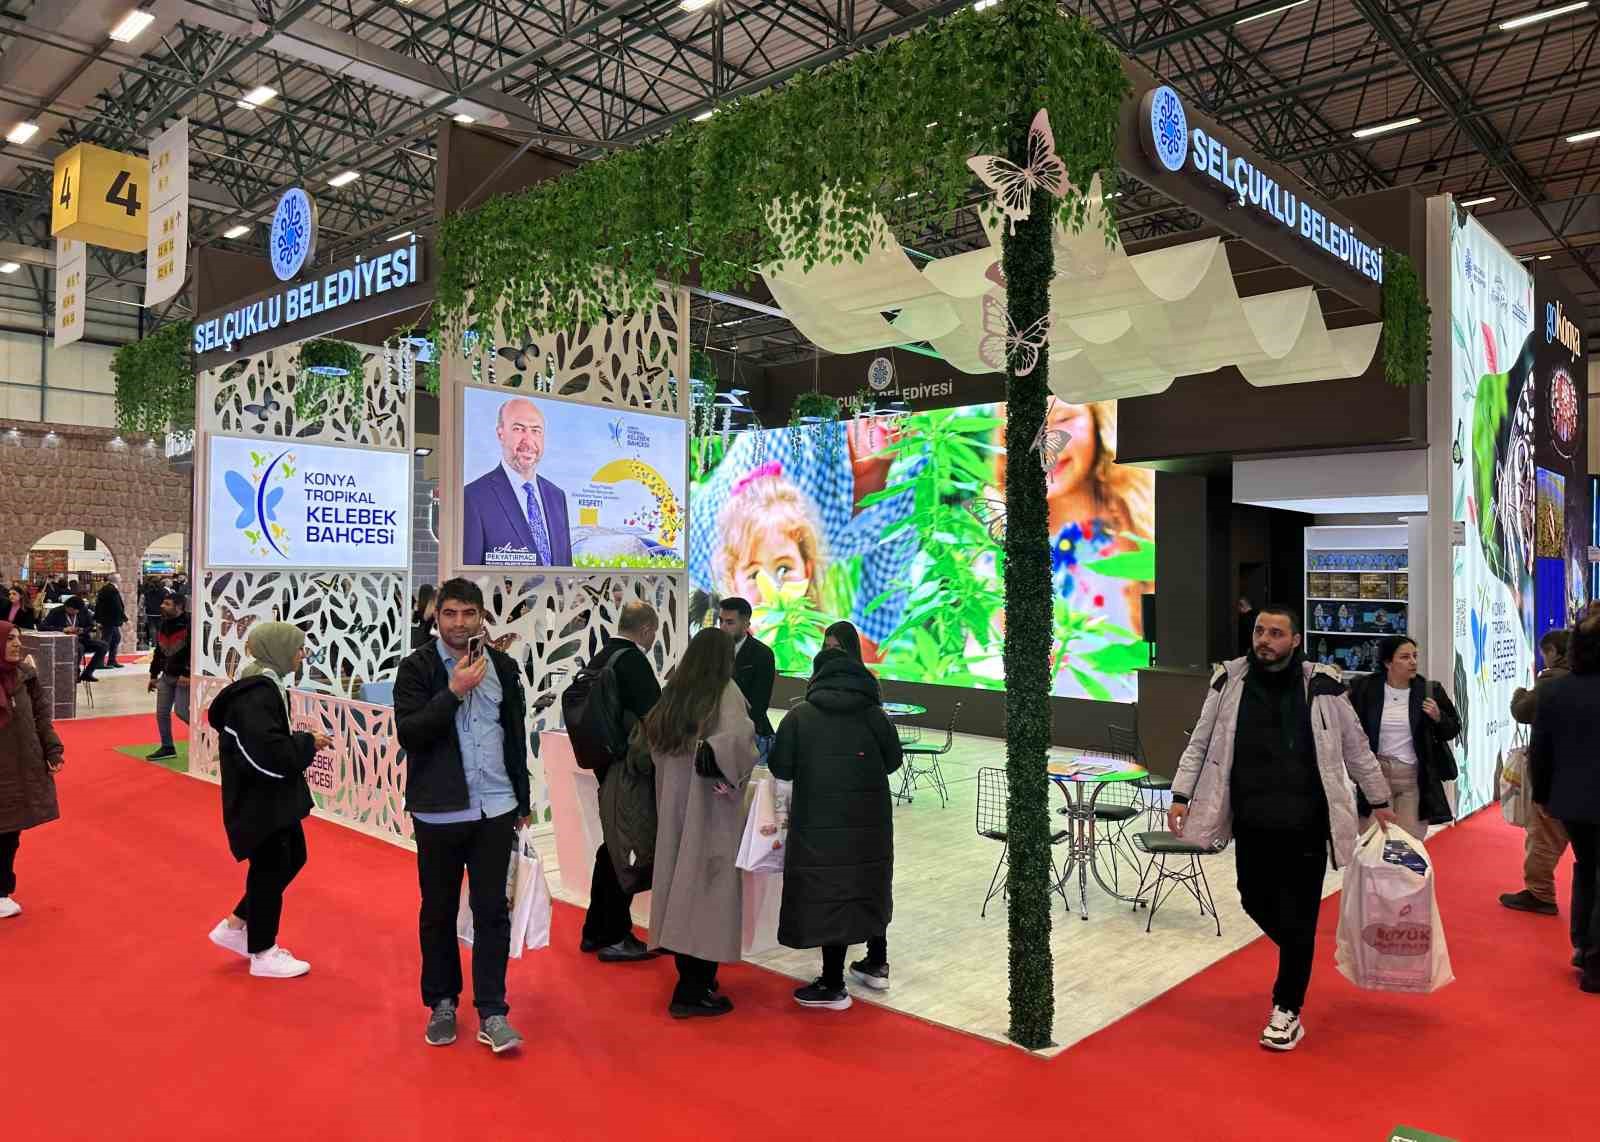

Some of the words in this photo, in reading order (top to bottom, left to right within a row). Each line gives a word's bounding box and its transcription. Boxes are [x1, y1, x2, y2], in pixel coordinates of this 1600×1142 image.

[59, 167, 71, 211] 4
[105, 170, 142, 217] 4
[1192, 127, 1296, 228] SELÇUKLU
[1300, 201, 1383, 285] BELEDİYESİ
[194, 294, 281, 354] SELÇUKLU
[285, 234, 417, 323] BELEDİYESİ
[1546, 299, 1581, 363] goKonya
[304, 471, 357, 488] KONYA
[306, 506, 398, 526] KELEBEK
